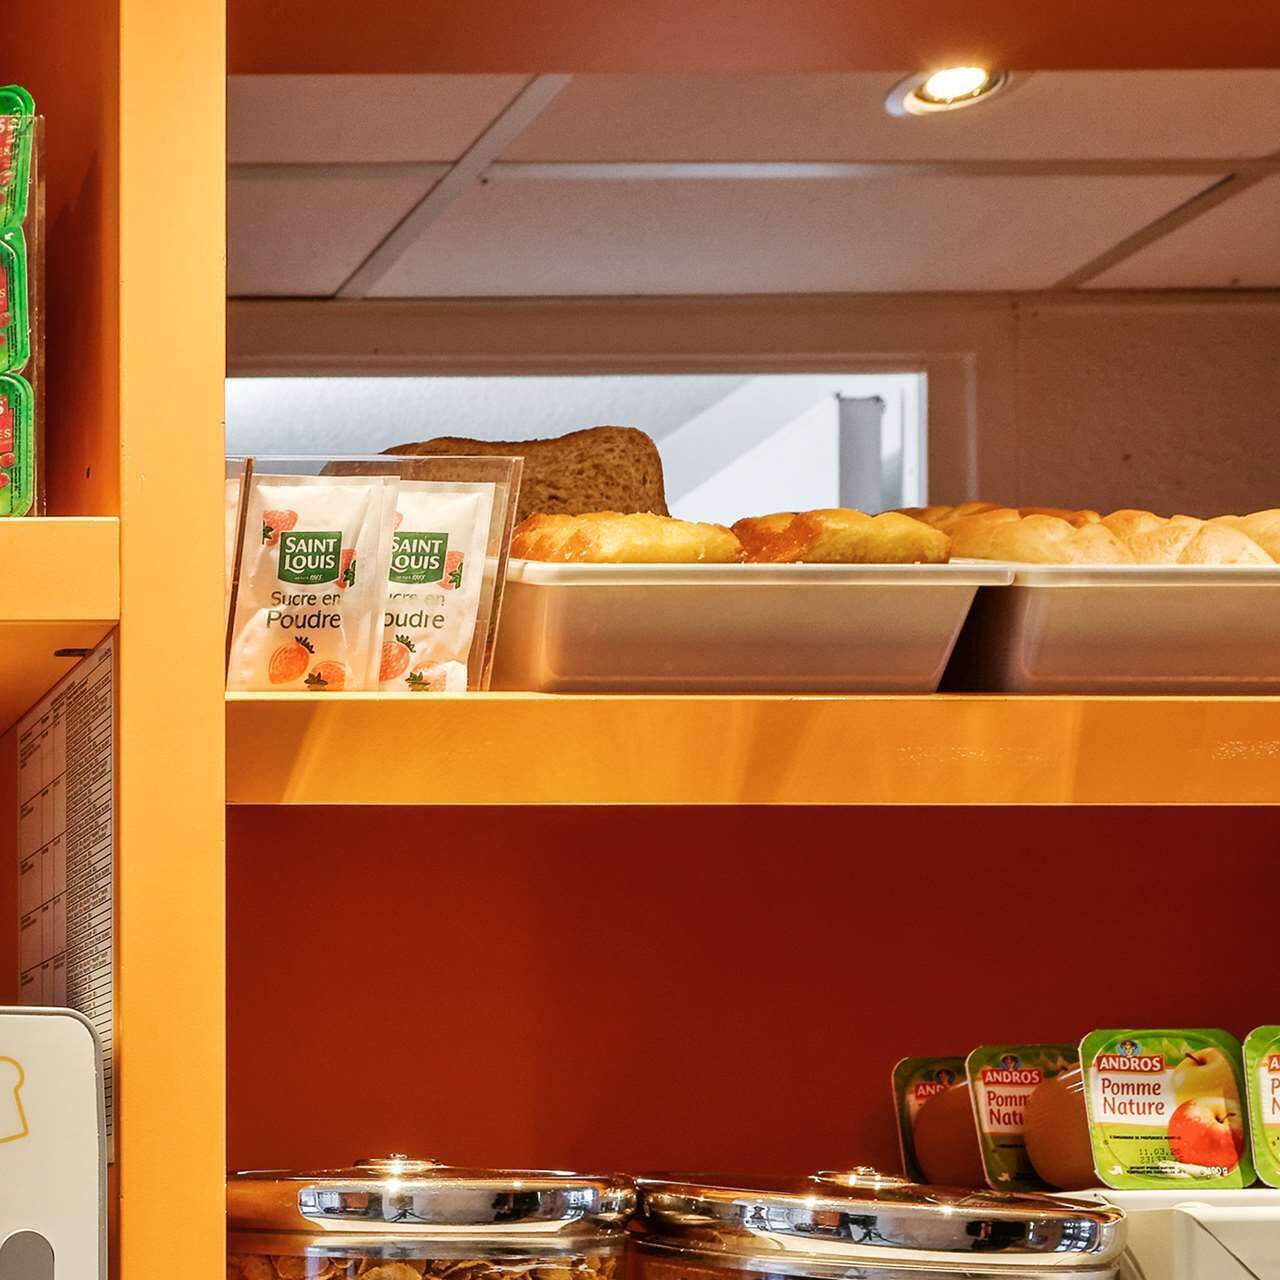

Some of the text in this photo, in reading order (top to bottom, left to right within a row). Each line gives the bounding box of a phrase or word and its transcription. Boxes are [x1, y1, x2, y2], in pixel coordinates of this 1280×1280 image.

[285, 537, 337, 553] SAINT
[392, 537, 443, 554] SAINT
[285, 555, 335, 573] LOUIS
[390, 555, 440, 573] LOUIS
[271, 591, 317, 606] Sucre
[267, 610, 341, 628] Poudre
[384, 610, 445, 628] oudre
[1100, 1057, 1161, 1071] ANDROS
[985, 1070, 1040, 1083] ANDROS
[1101, 1078, 1161, 1095] Pomme
[987, 1091, 1030, 1106] Pomm
[1103, 1097, 1165, 1115] Nature
